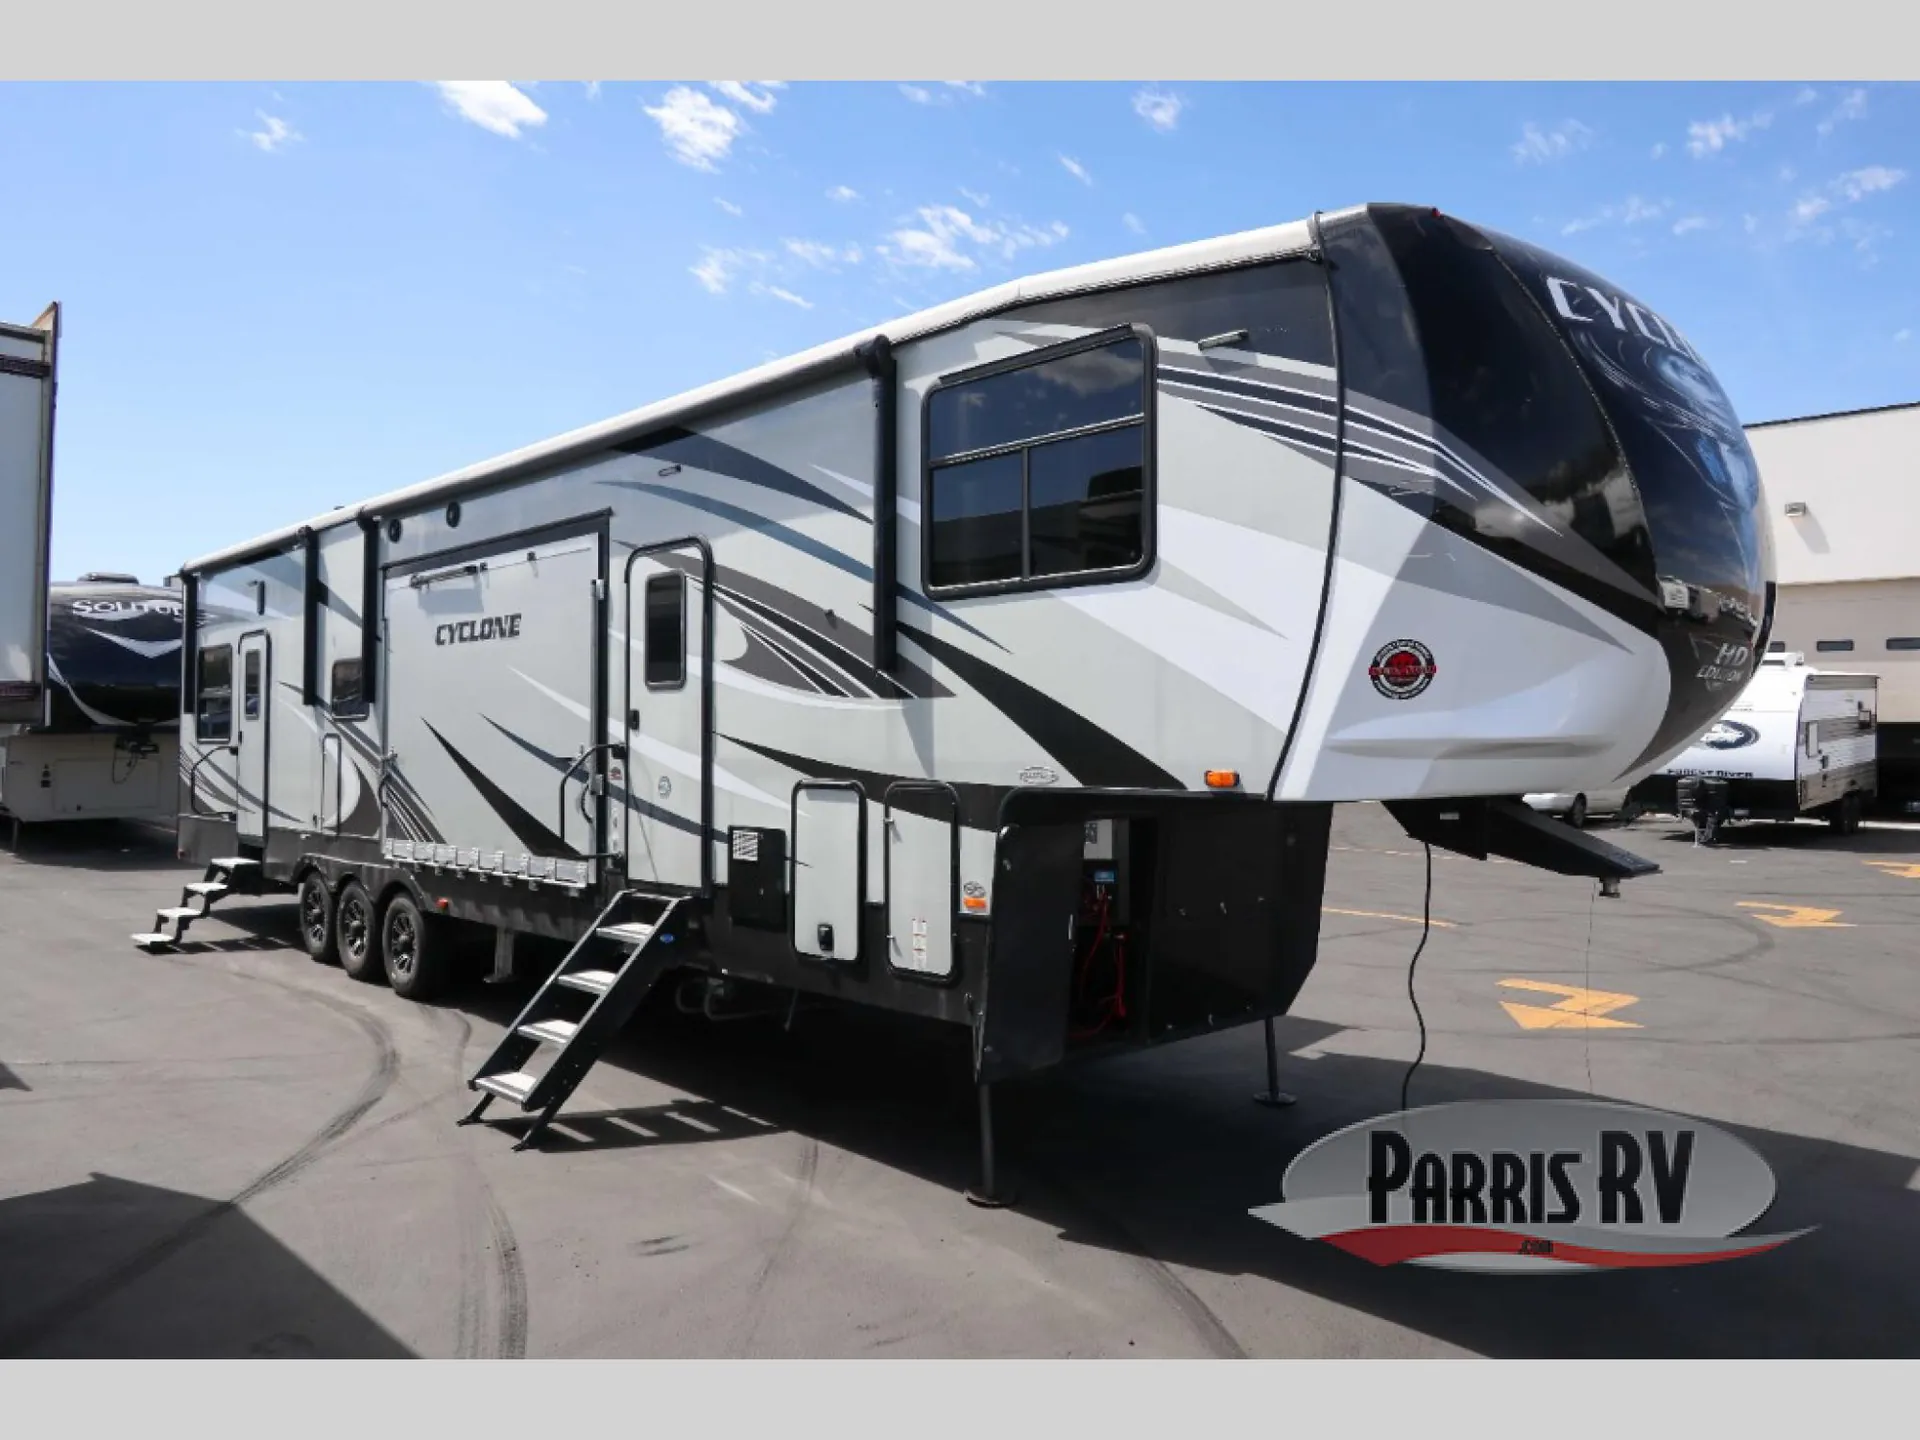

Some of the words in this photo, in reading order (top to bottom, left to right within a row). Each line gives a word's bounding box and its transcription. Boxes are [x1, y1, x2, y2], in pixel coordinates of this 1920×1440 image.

[435, 613, 522, 646] CYCLONE
[1715, 642, 1749, 667] HD
[1716, 769, 1754, 779] RIVER
